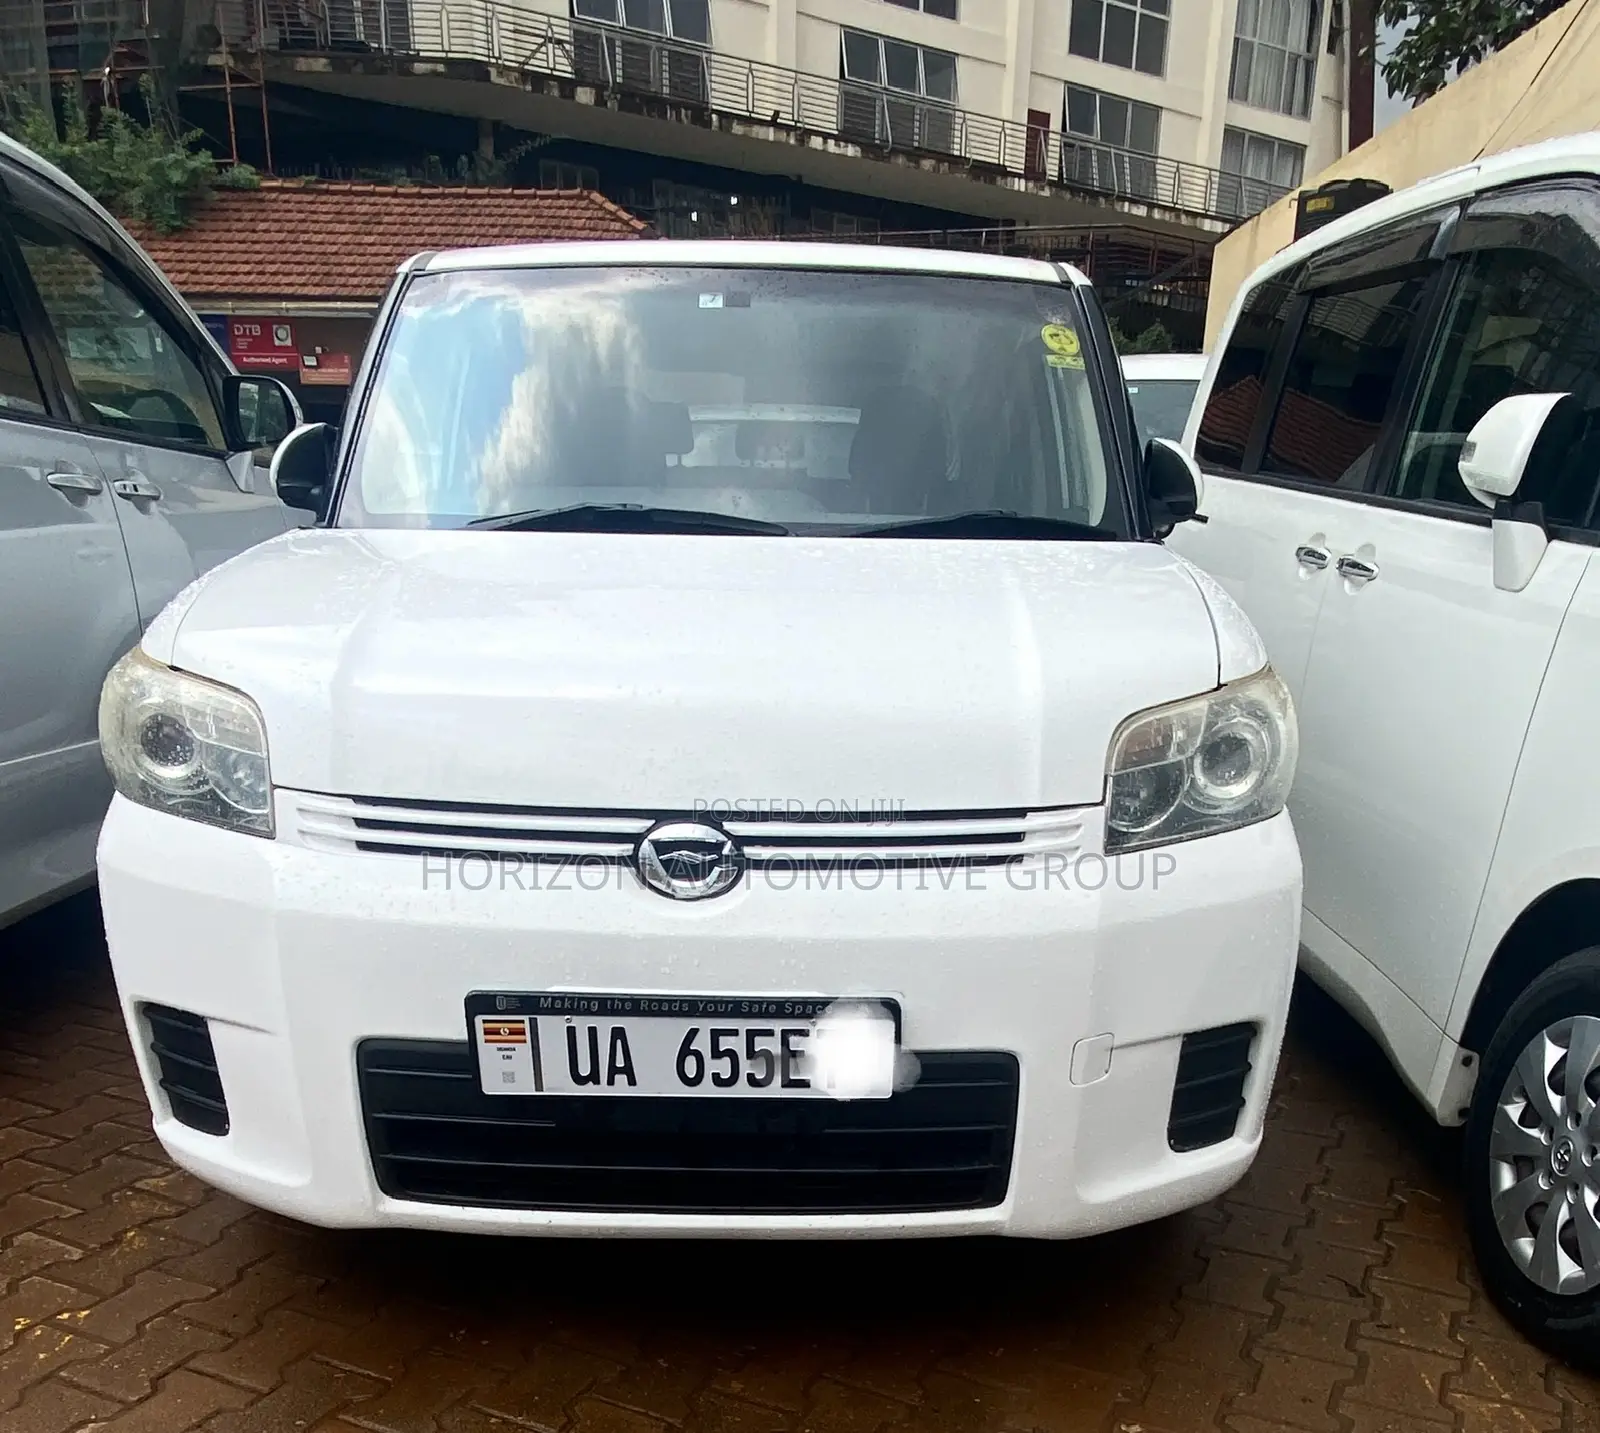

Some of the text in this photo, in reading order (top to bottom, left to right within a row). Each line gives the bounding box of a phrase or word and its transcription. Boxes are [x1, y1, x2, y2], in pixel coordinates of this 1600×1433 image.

[233, 324, 261, 336] DTB
[272, 357, 288, 365] Agent
[539, 997, 833, 1015] Making the Roads Your Safe Space
[566, 1025, 838, 1089] UA 655E
